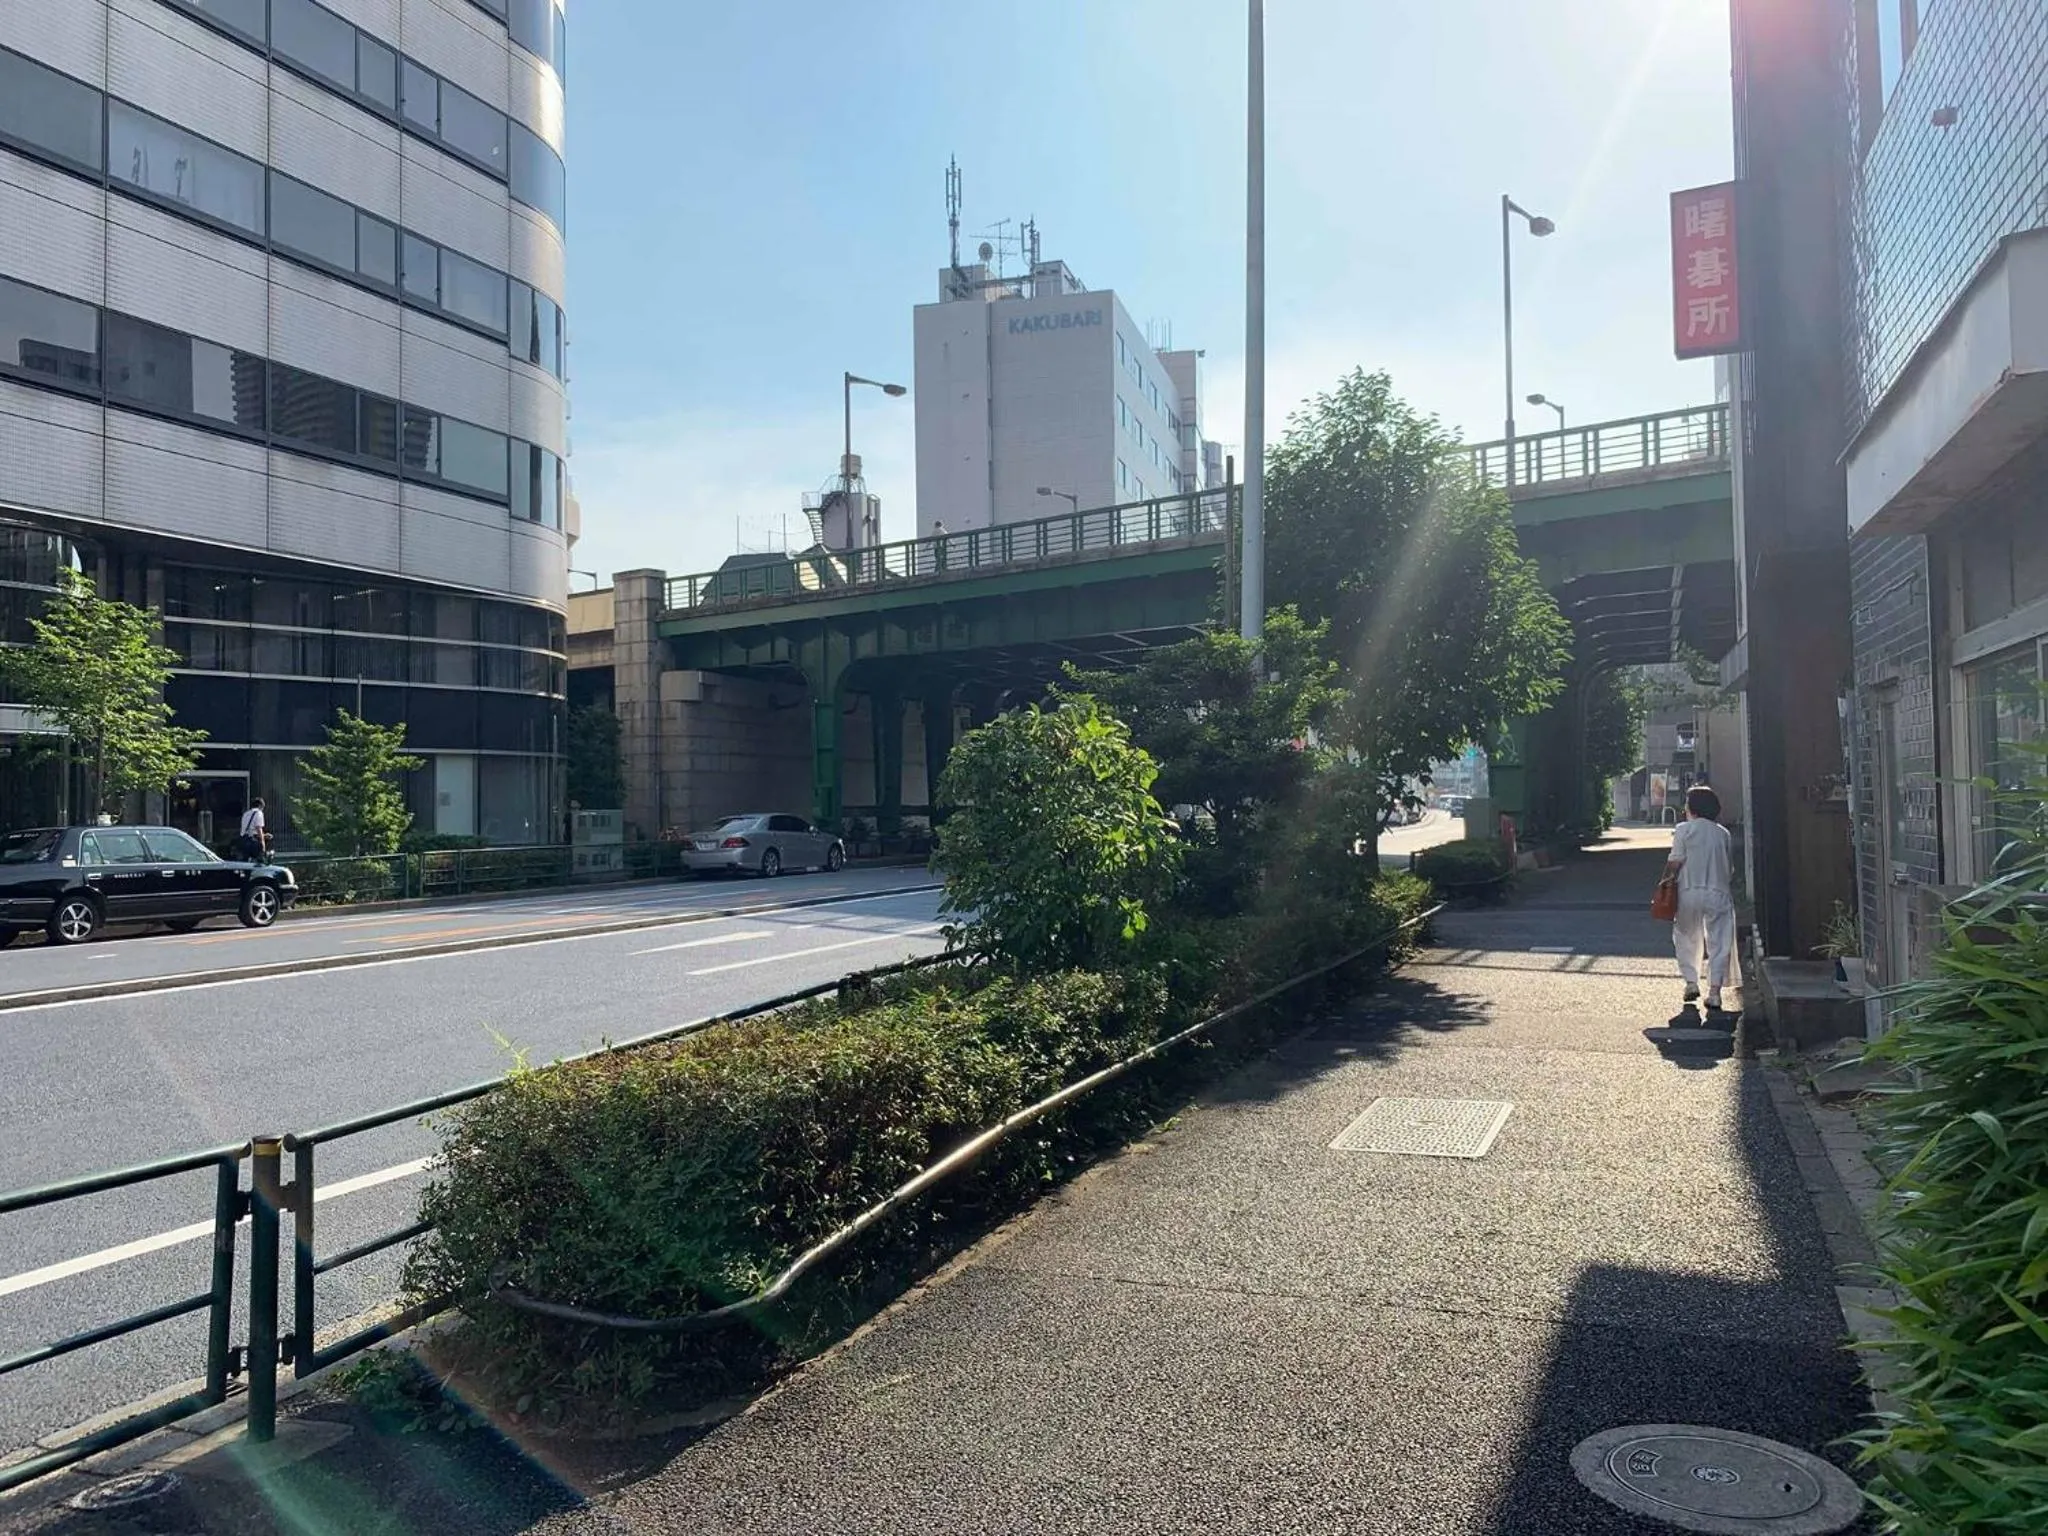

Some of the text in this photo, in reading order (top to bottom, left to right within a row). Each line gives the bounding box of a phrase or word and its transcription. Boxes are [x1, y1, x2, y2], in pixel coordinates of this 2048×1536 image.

[1684, 198, 1730, 338] 曙碁所
[1008, 309, 1102, 335] KAKUBARI
